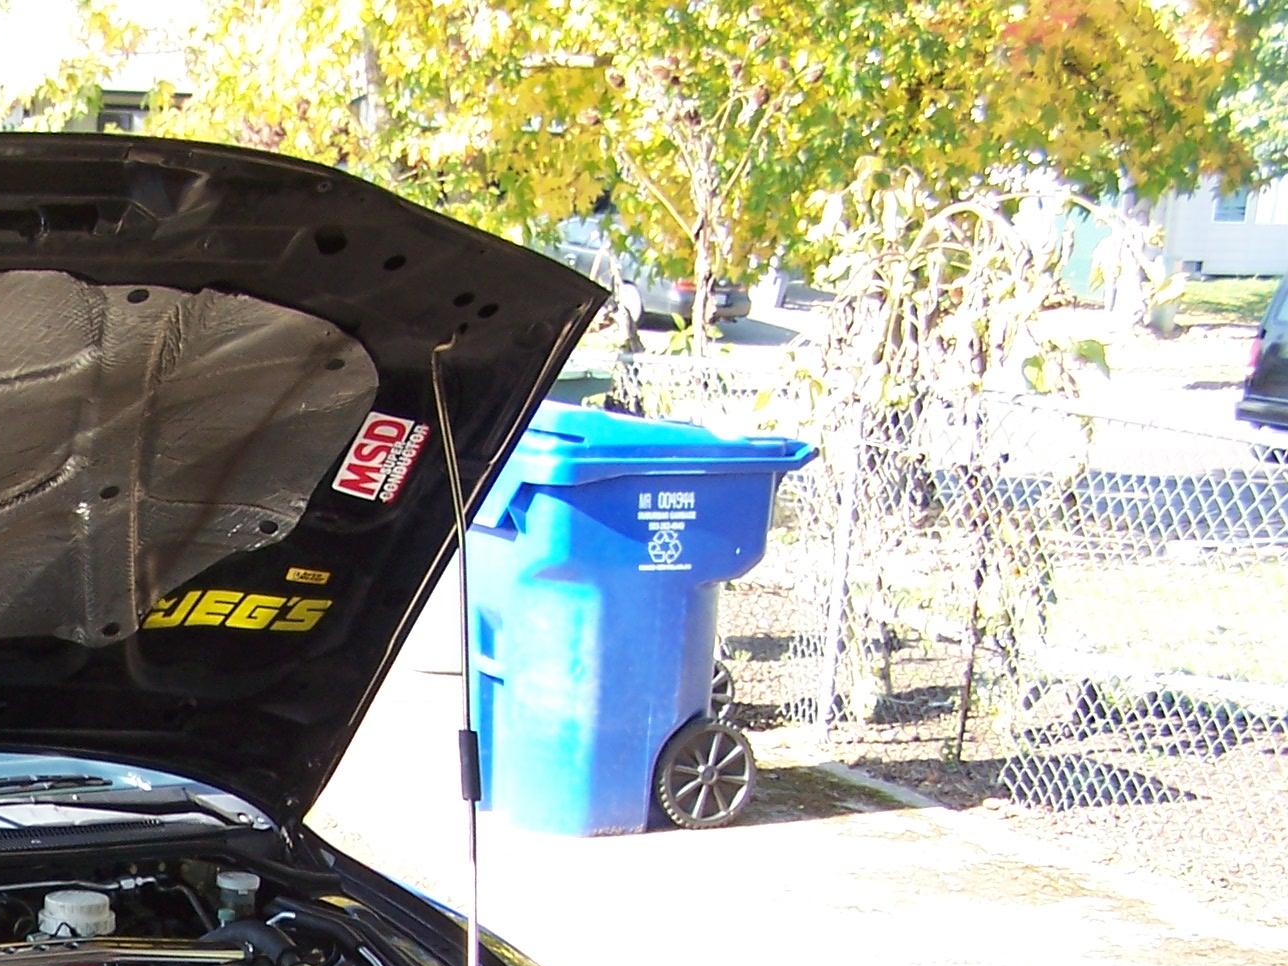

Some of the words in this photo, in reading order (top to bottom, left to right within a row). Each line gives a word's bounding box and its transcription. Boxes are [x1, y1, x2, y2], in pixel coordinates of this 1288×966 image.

[338, 419, 407, 496] MSD
[379, 424, 430, 503] CONDUCTOR
[380, 441, 405, 475] SUPER
[142, 590, 333, 631] JEG'S
